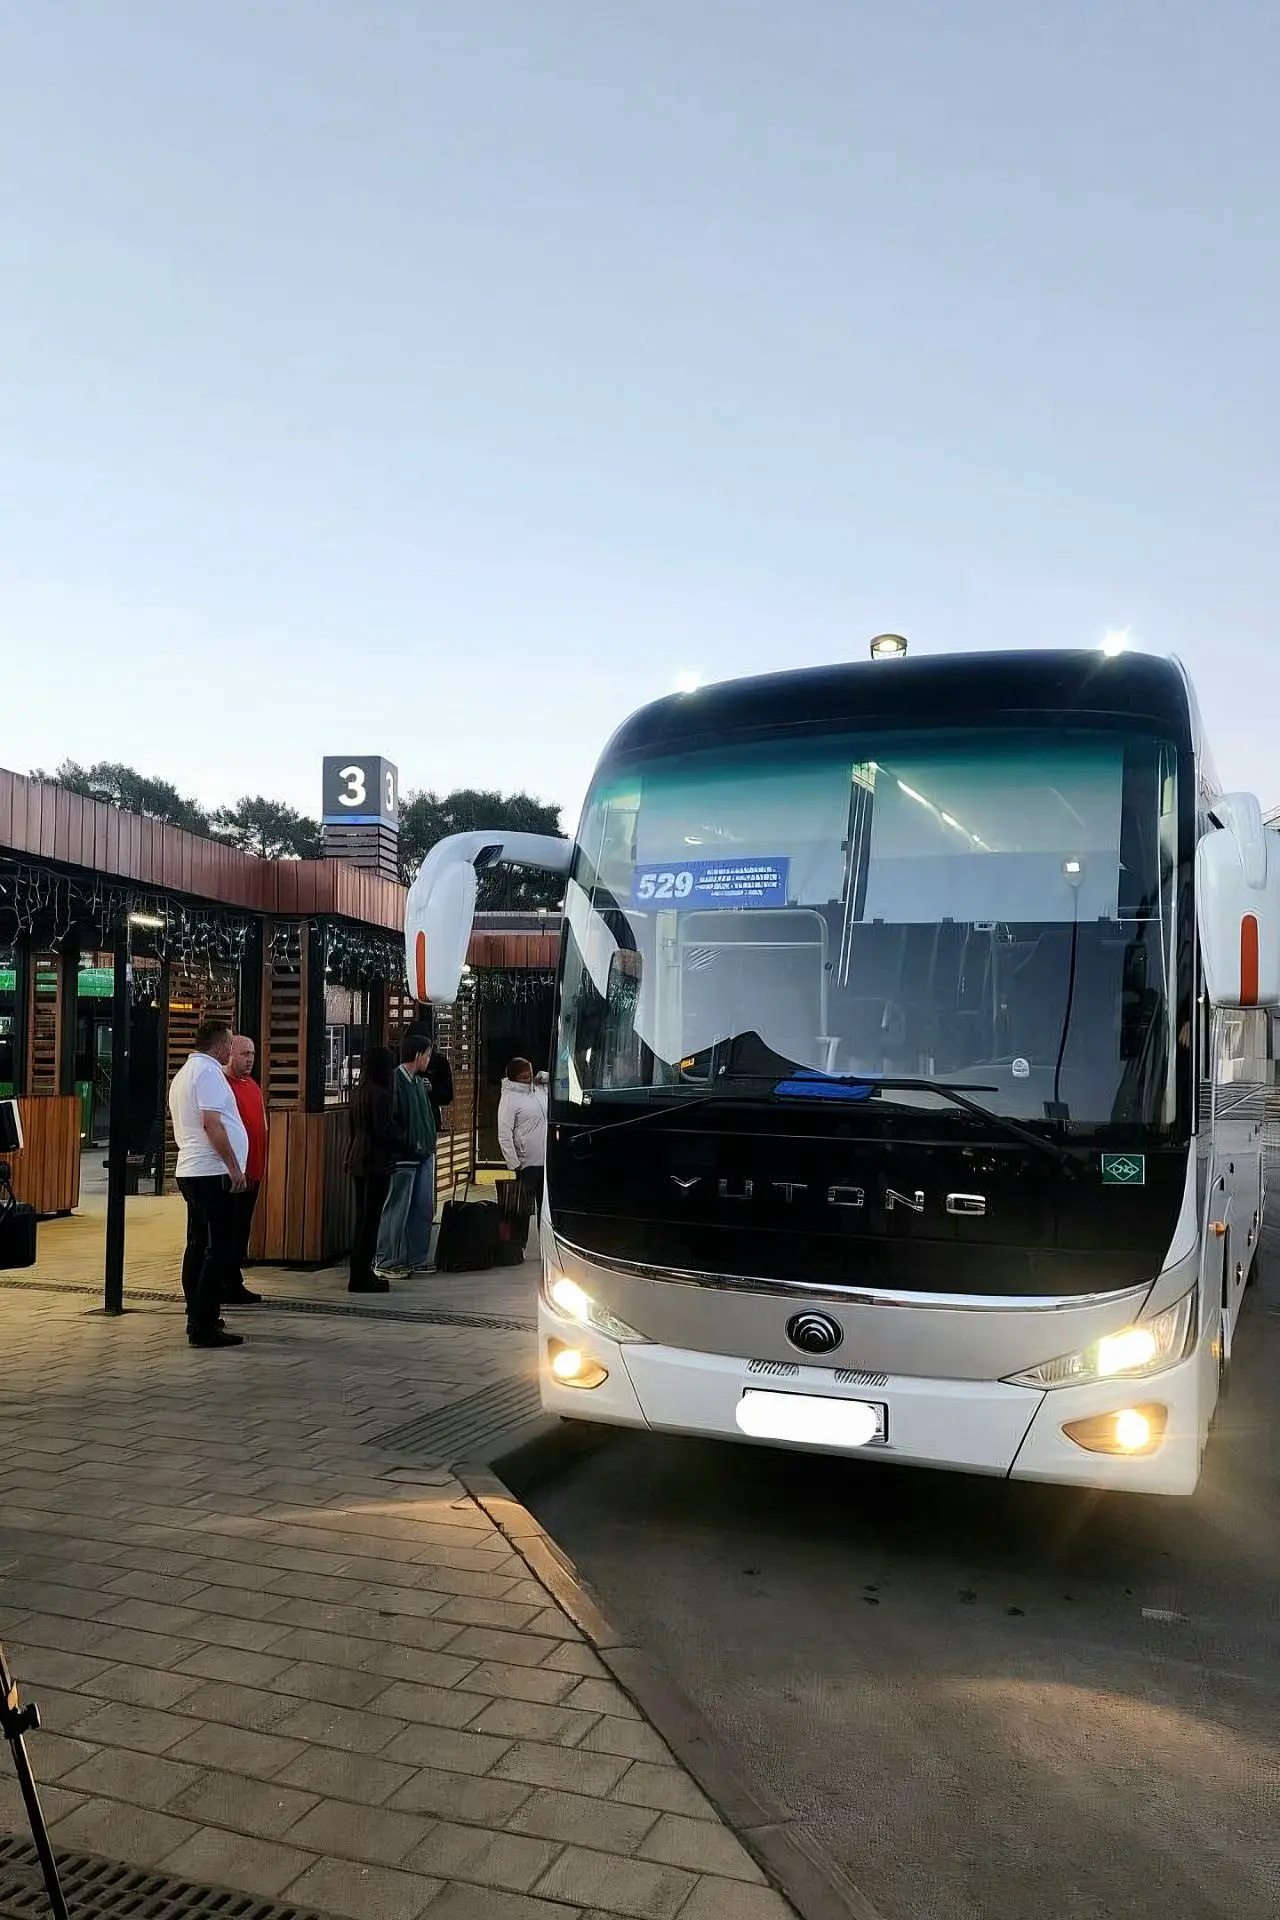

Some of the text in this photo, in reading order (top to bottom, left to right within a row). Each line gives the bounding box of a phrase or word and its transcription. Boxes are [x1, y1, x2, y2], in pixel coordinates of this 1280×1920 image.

[338, 765, 366, 806] 3
[385, 771, 394, 811] 3
[636, 871, 694, 899] 529
[670, 1175, 986, 1216] YUTONG
